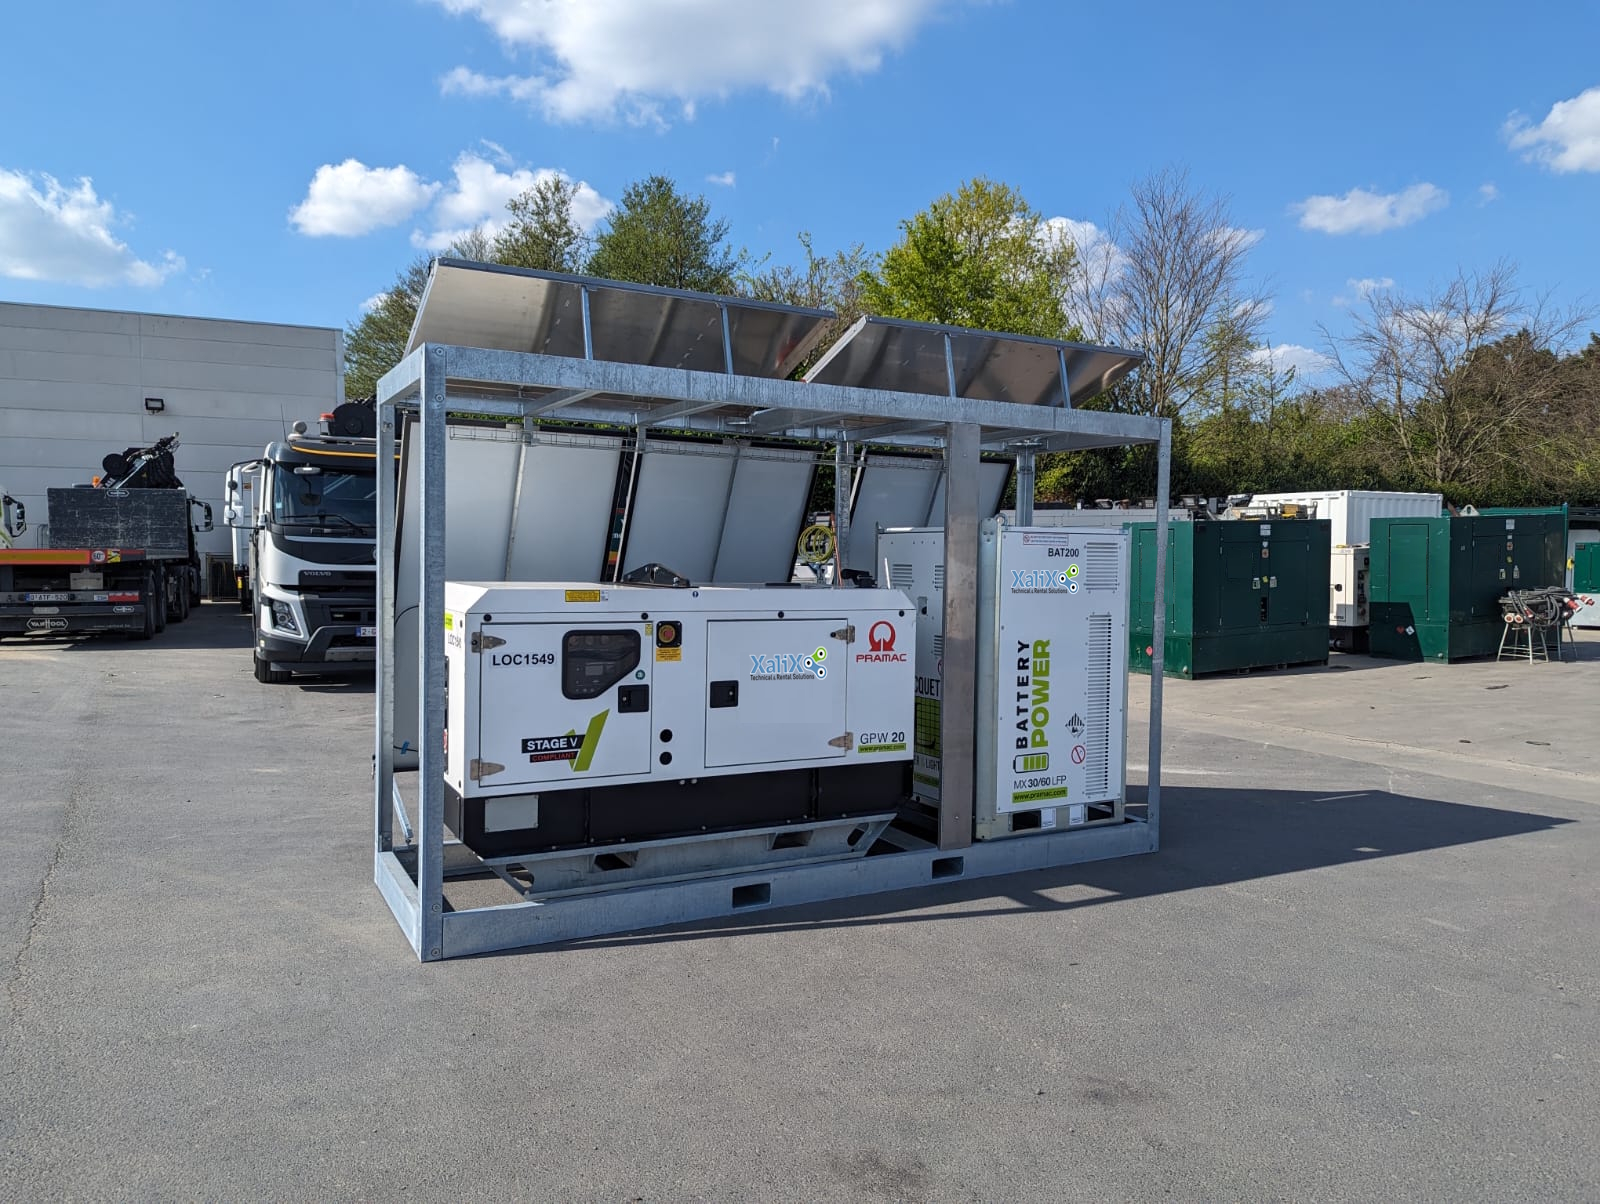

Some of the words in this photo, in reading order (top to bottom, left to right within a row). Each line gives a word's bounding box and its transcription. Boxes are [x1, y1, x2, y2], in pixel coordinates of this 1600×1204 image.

[1048, 548, 1080, 558] BAT200
[1011, 569, 1059, 588] XaliX
[492, 653, 555, 666] LOC1549
[749, 654, 804, 675] XaliX
[856, 653, 907, 663] PRAMAC
[1016, 640, 1030, 750] BATTERY
[1031, 639, 1051, 749] POWER
[527, 737, 568, 751] STAGE
[569, 737, 578, 747] V
[860, 732, 889, 744] GPW
[891, 731, 905, 742] 20
[531, 752, 576, 761] COMPLIANT
[1013, 779, 1027, 790] MX
[1027, 776, 1051, 788] 30/60
[1051, 775, 1067, 786] LFP
[1014, 788, 1067, 801] www.pramac.com
